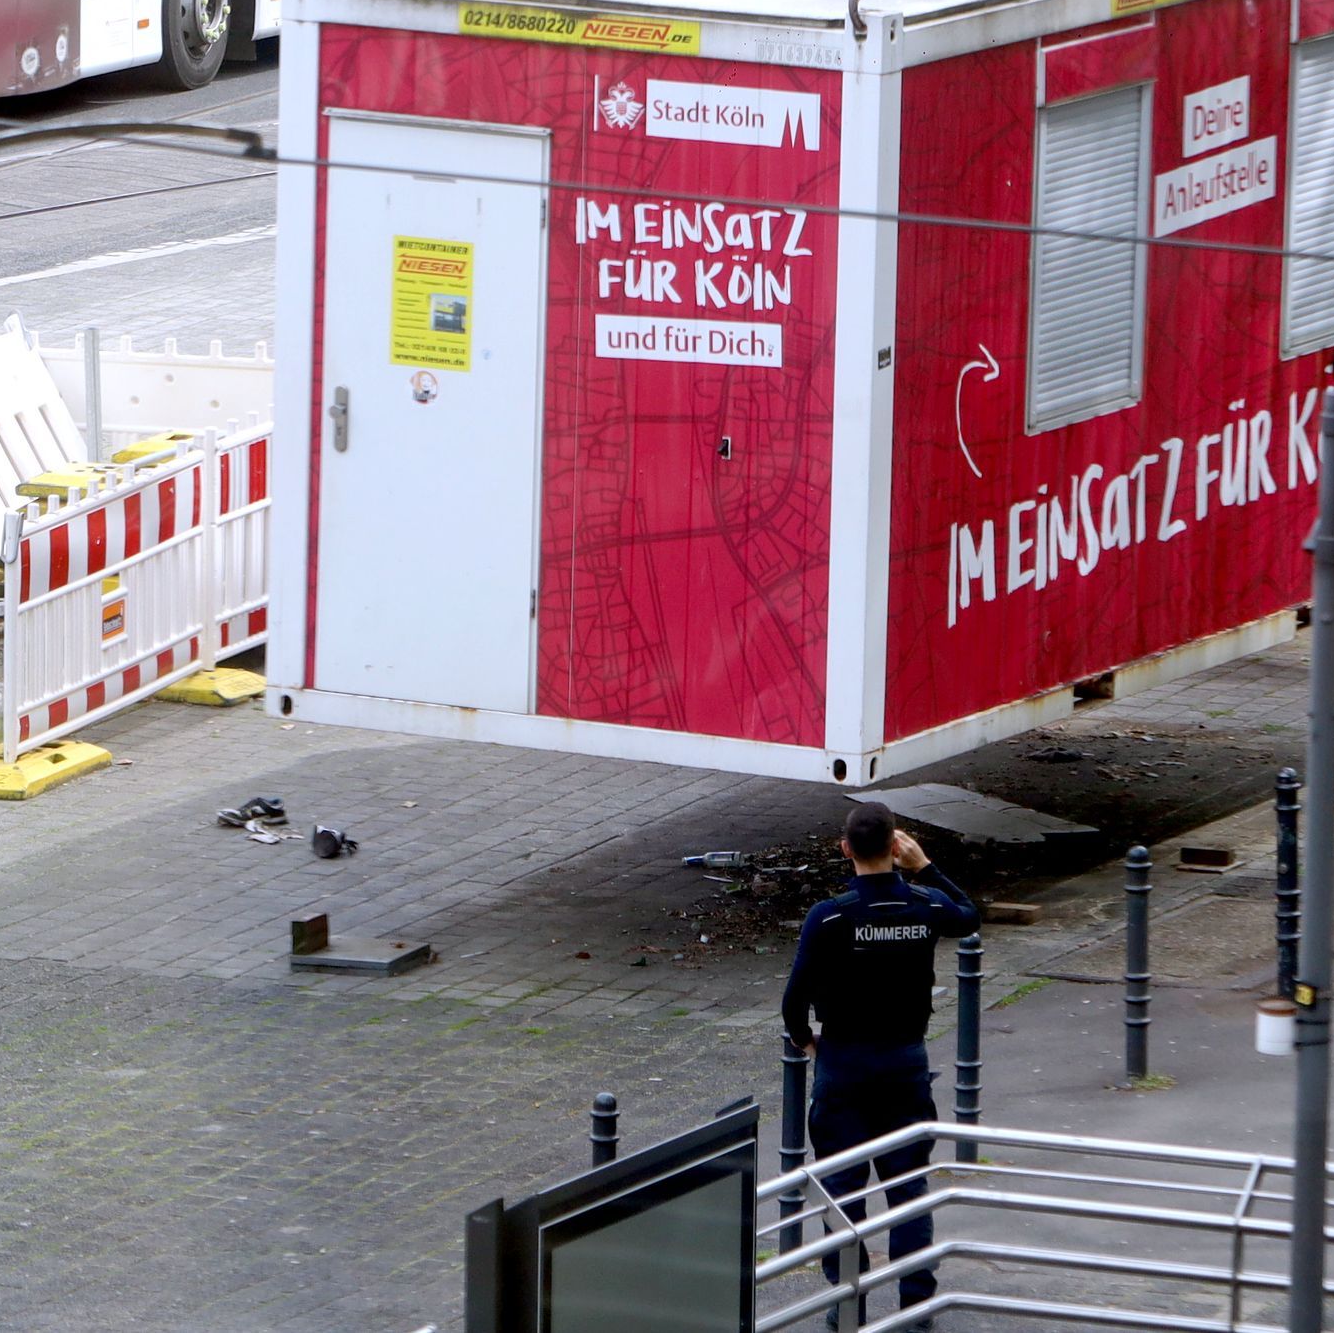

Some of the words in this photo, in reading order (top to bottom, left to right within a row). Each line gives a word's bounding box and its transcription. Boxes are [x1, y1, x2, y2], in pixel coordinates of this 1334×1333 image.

[462, 10, 577, 36] 0214/8680220
[652, 99, 710, 124] Stadt
[715, 104, 765, 128] Köln
[1193, 98, 1244, 141] Deine
[1163, 150, 1269, 220] Anlaufstelle
[575, 197, 622, 244] IM
[400, 259, 465, 275] NIESEN
[598, 249, 682, 304] FÜR
[607, 325, 656, 352] und
[663, 325, 702, 353] für
[708, 330, 773, 358] Dich.
[948, 518, 997, 629] IM
[1195, 397, 1277, 521] FÜR
[855, 924, 928, 941] KÜMMERER
